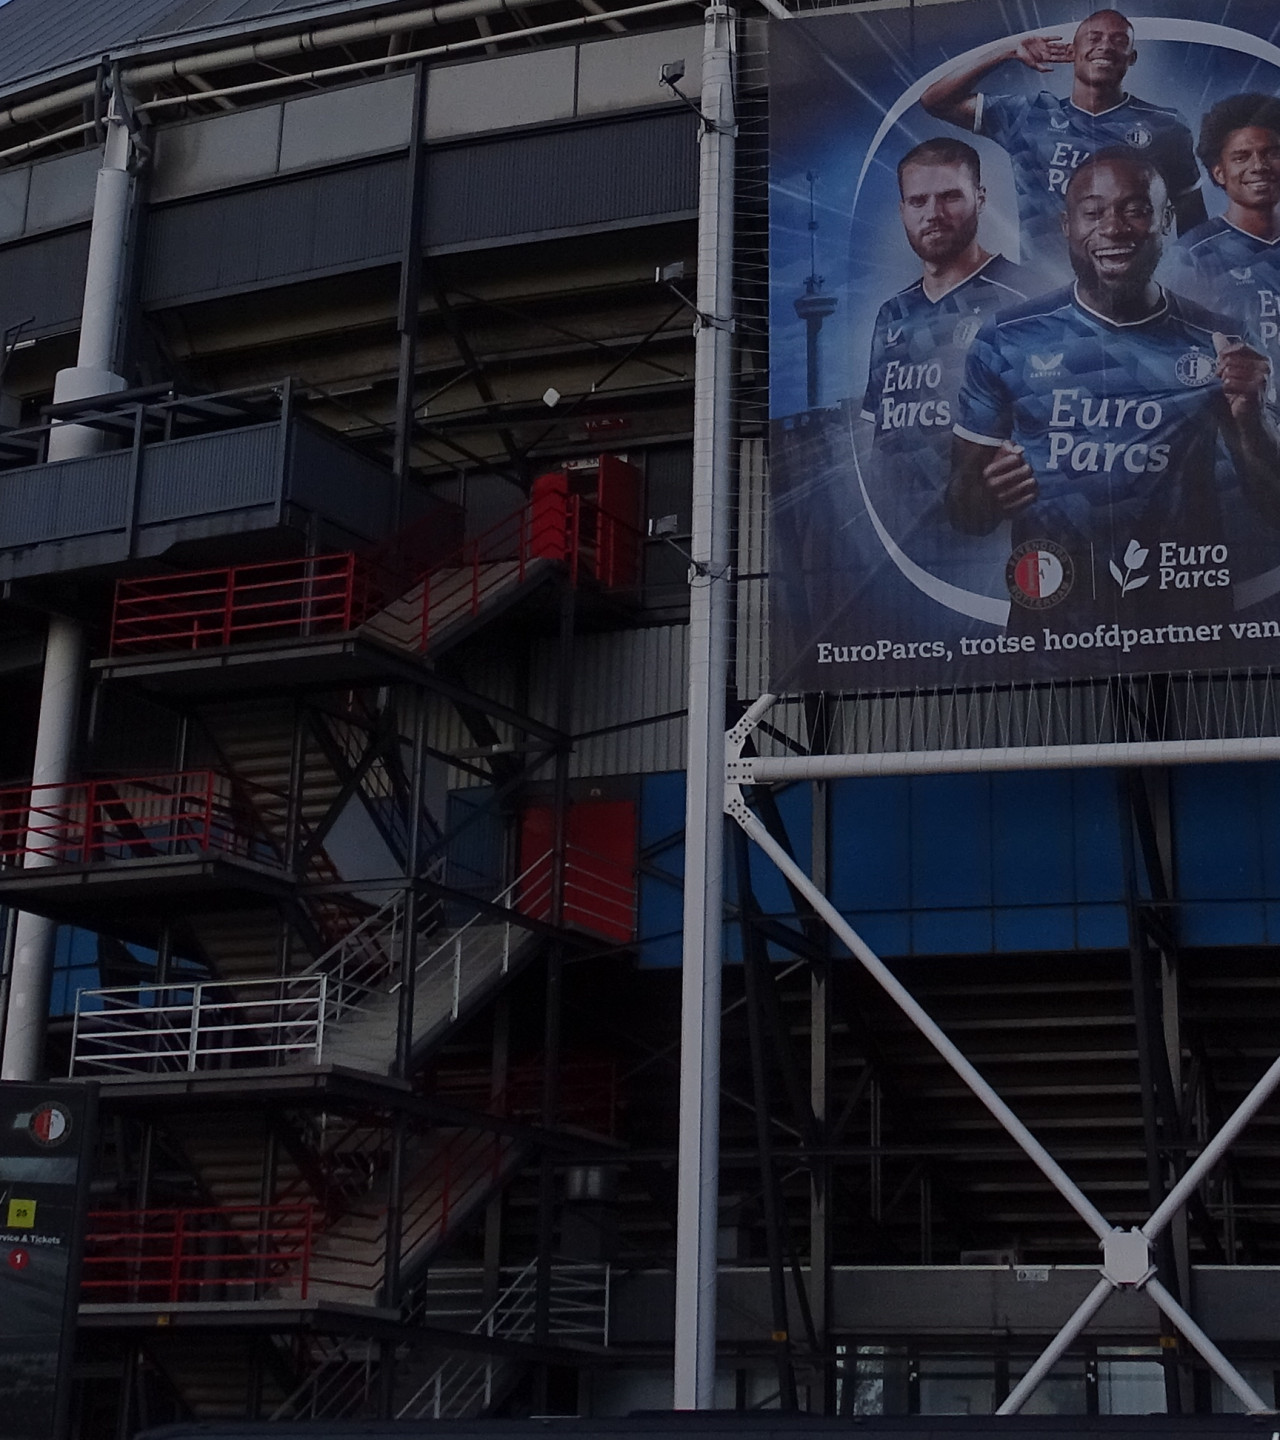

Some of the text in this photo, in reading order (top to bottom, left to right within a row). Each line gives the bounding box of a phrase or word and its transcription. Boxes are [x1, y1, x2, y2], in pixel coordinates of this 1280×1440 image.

[1050, 143, 1090, 168] Eu
[882, 360, 941, 394] Euro
[881, 398, 950, 430] Parcs
[1048, 389, 1163, 430] Euro
[1046, 432, 1171, 473] Parcs
[1159, 542, 1228, 567] Euro
[1159, 567, 1230, 589] Parcs
[817, 640, 953, 663] EuroParcs,
[960, 634, 1036, 656] trotse
[1043, 624, 1223, 652] hoofdpartner
[1229, 620, 1280, 640] van
[31, 1235, 61, 1245] Tickets
[15, 1253, 23, 1264] 1
